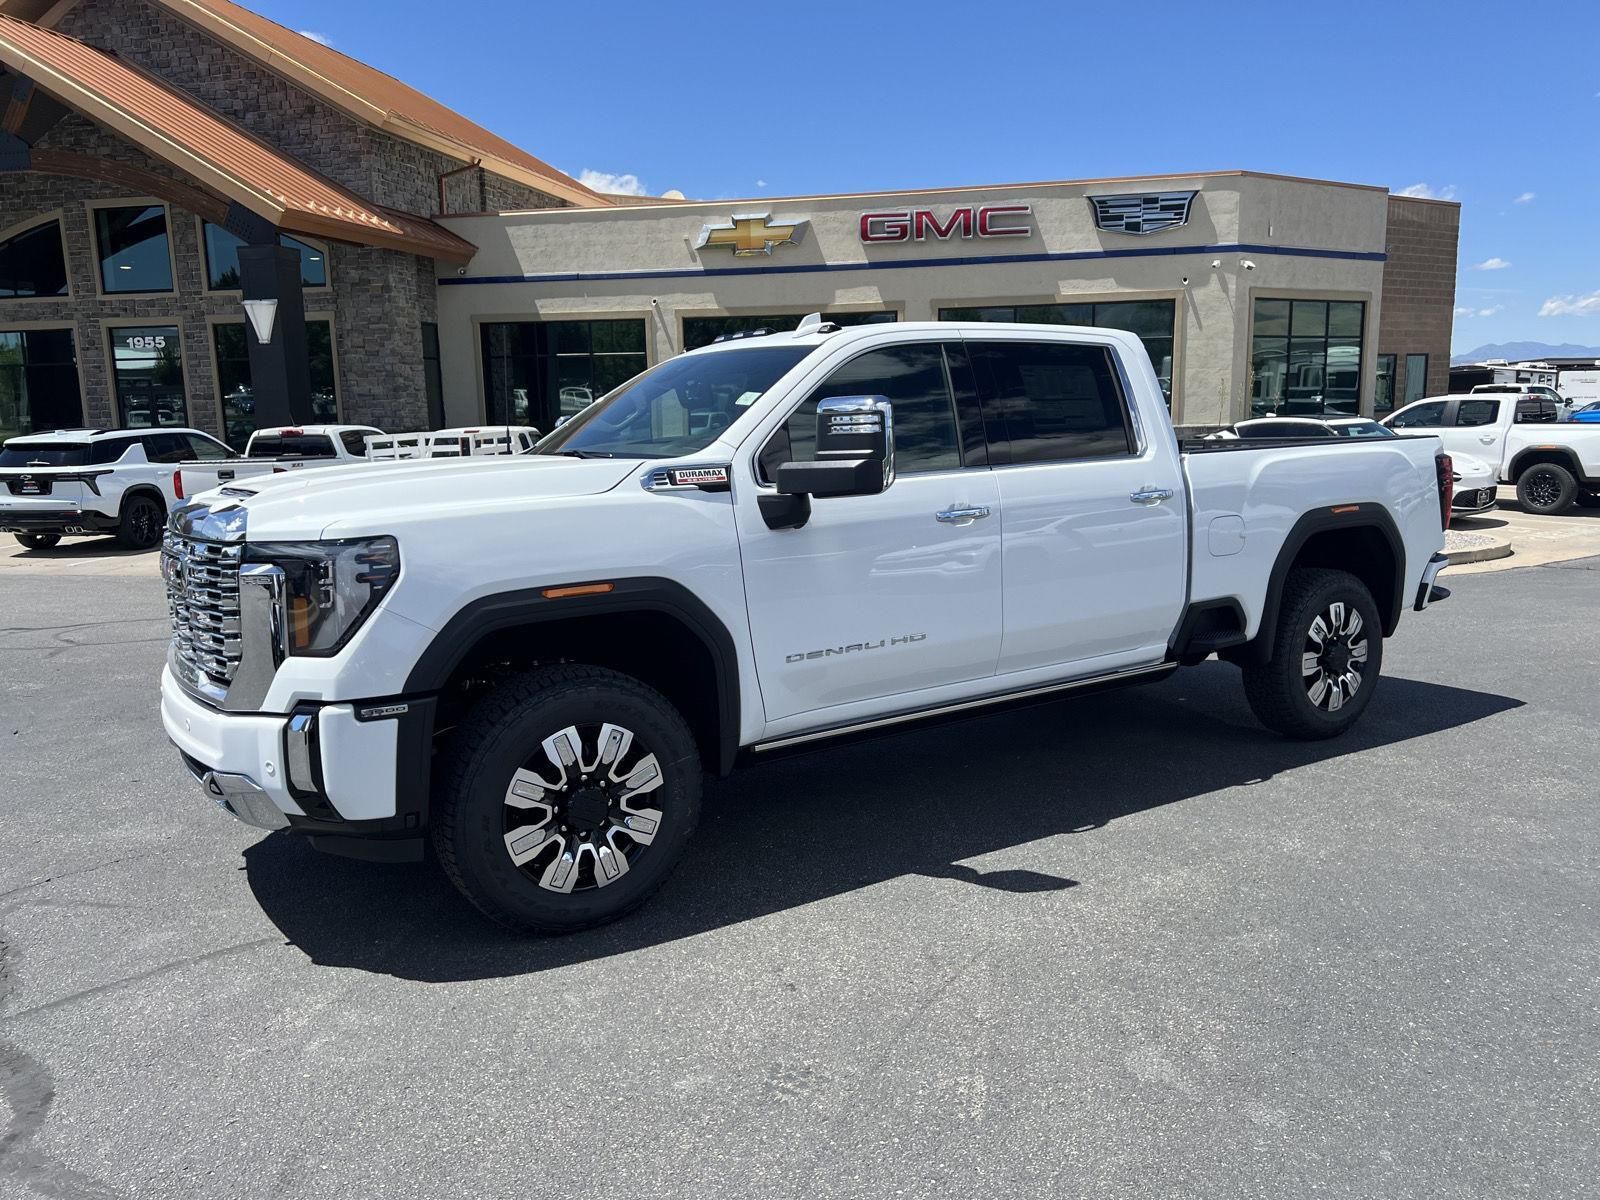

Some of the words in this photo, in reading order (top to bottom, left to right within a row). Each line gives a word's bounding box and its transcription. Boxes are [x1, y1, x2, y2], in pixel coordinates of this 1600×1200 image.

[860, 203, 1032, 245] GMC
[126, 336, 166, 349] 1955
[678, 469, 723, 479] DURAMAX
[785, 639, 885, 664] DENALI
[890, 632, 927, 646] HD
